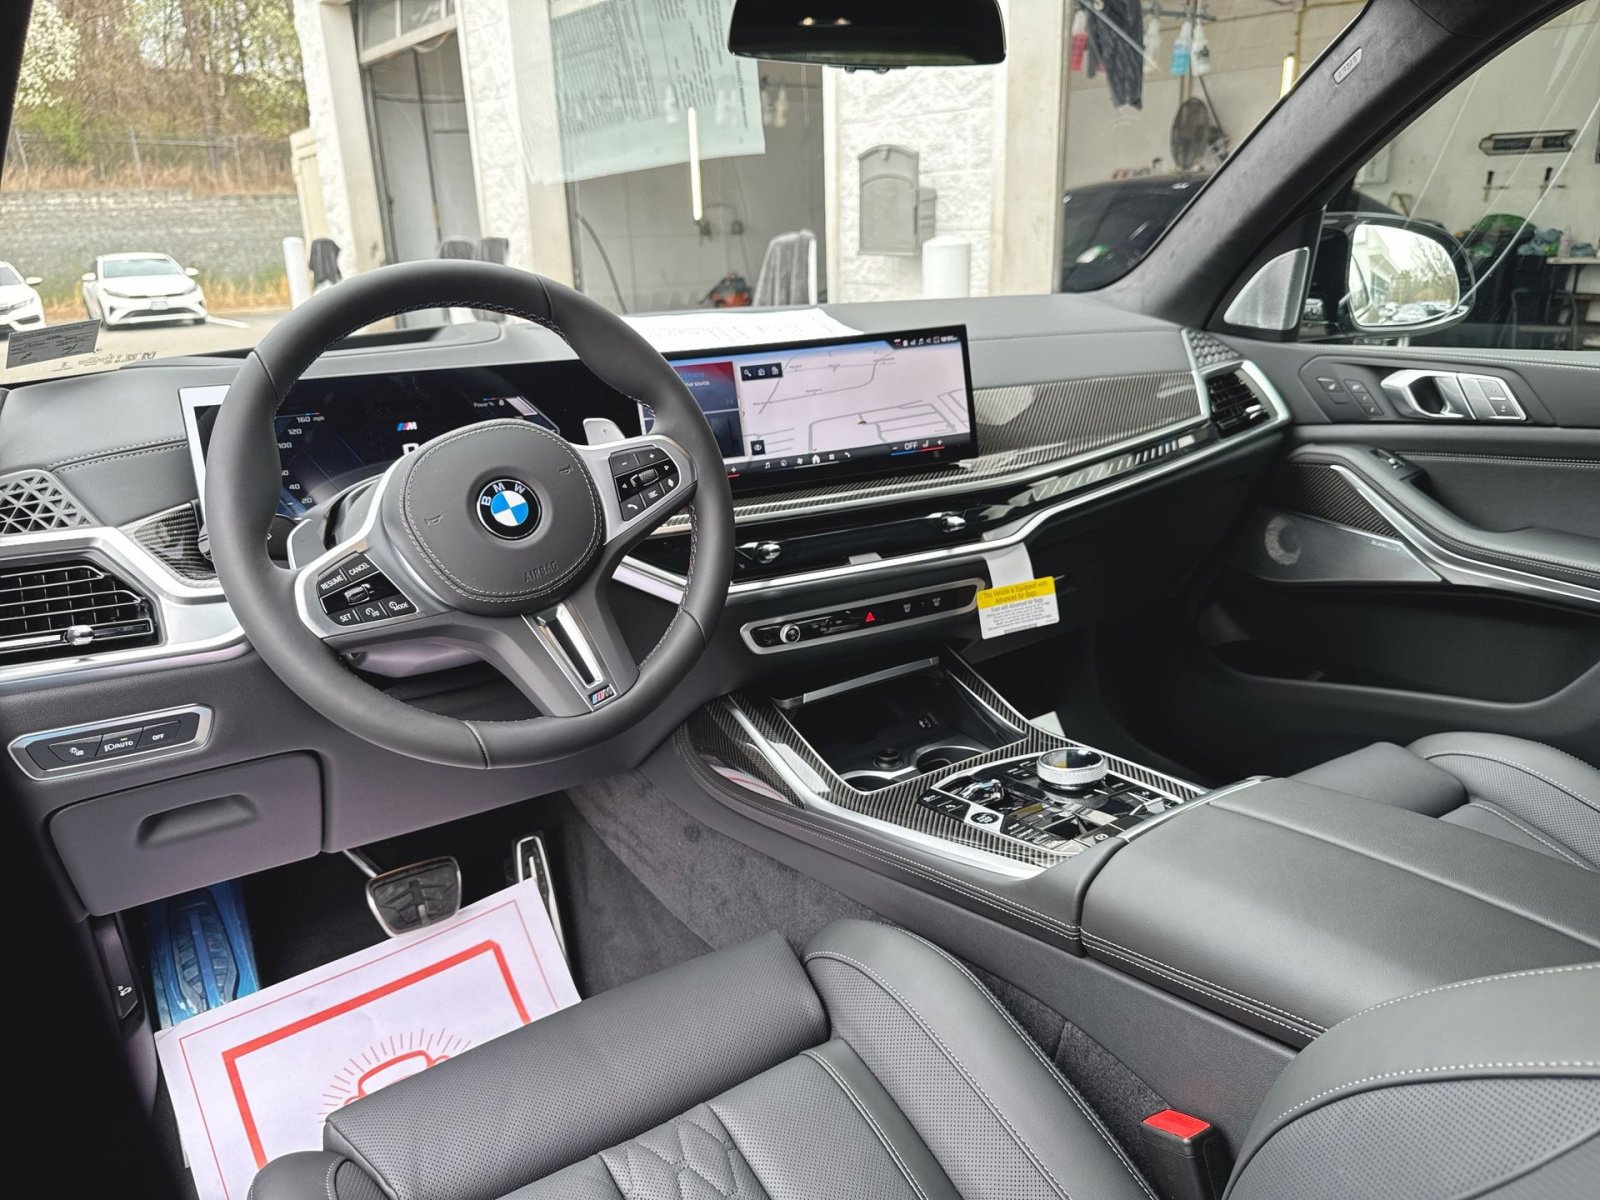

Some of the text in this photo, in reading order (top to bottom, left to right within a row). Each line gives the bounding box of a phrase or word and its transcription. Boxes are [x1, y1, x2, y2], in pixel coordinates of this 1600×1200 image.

[904, 442, 918, 450] OFF
[481, 482, 526, 507] BMW
[348, 562, 371, 576] CANCEL
[523, 561, 560, 582] AIRBAG
[320, 574, 345, 590] RESUME
[393, 602, 409, 611] MODE
[339, 613, 352, 623] SET
[152, 733, 165, 741] OFF
[116, 740, 134, 748] AUTO
